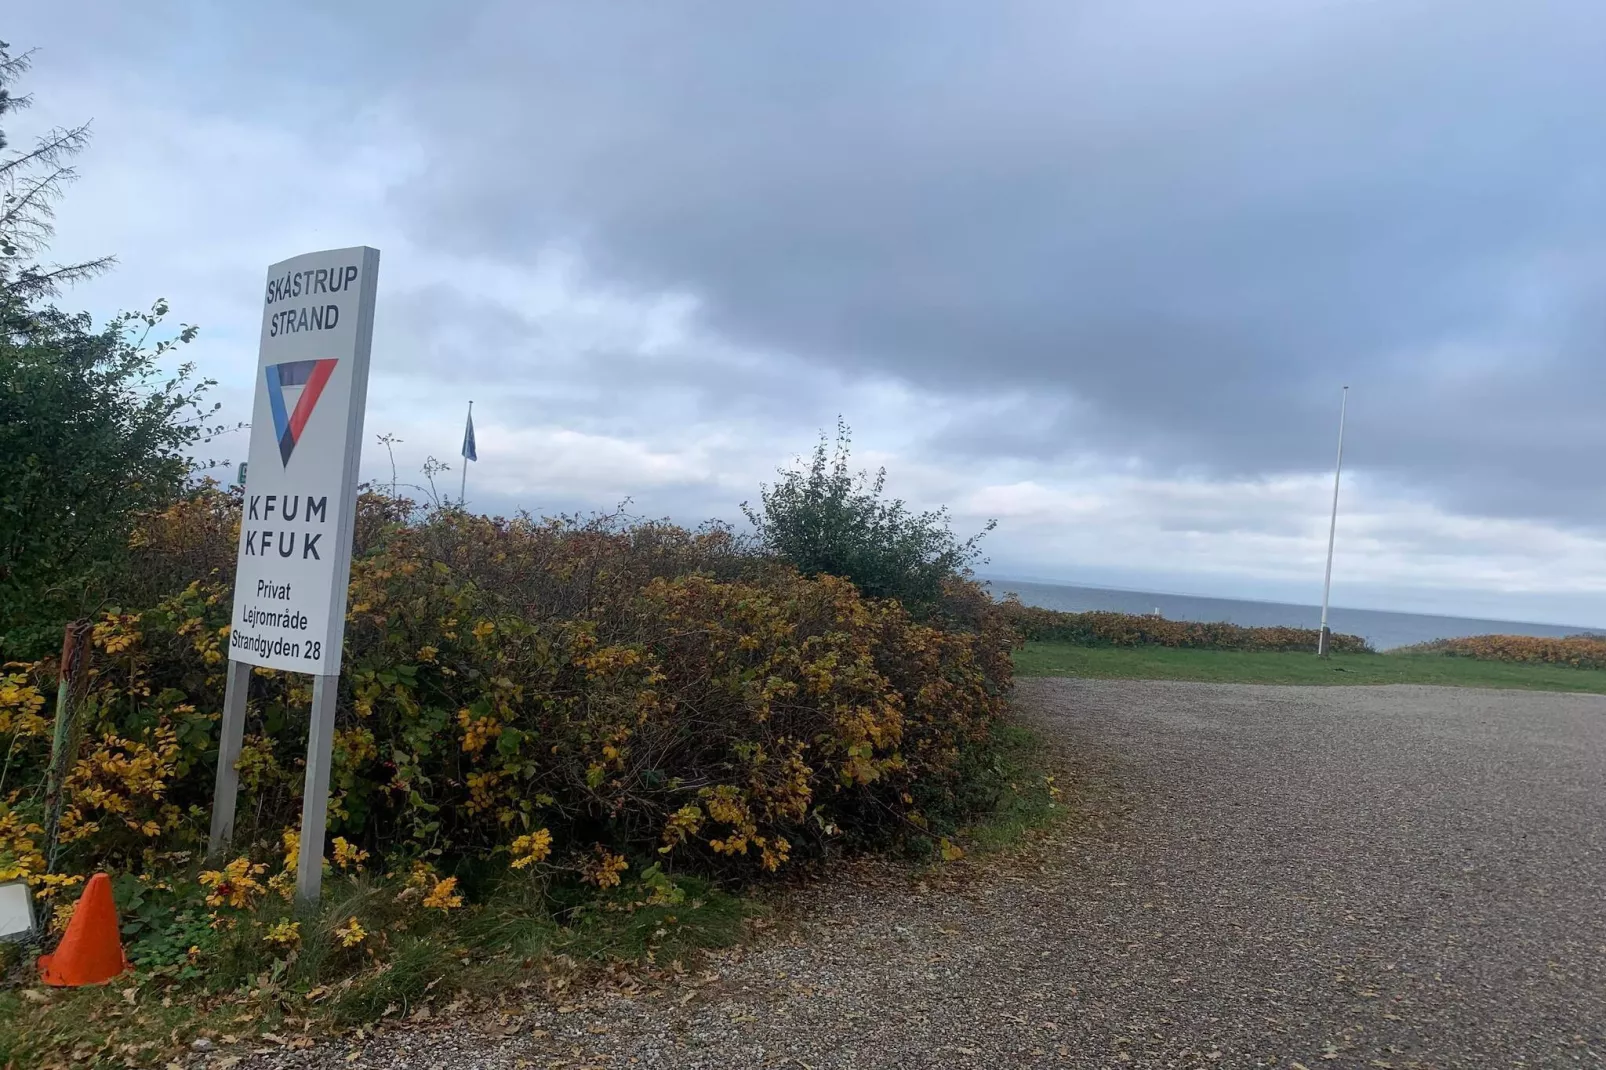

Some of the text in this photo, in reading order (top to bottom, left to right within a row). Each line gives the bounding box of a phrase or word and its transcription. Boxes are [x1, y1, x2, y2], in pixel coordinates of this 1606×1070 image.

[267, 266, 357, 304] SKÅSTRUP
[270, 305, 339, 337] STRAND
[248, 495, 327, 522] KFUM
[245, 530, 322, 560] KFUK
[257, 579, 291, 600] Privat
[243, 604, 308, 630] Lejrområde
[232, 630, 321, 660] Strandgyden 28
